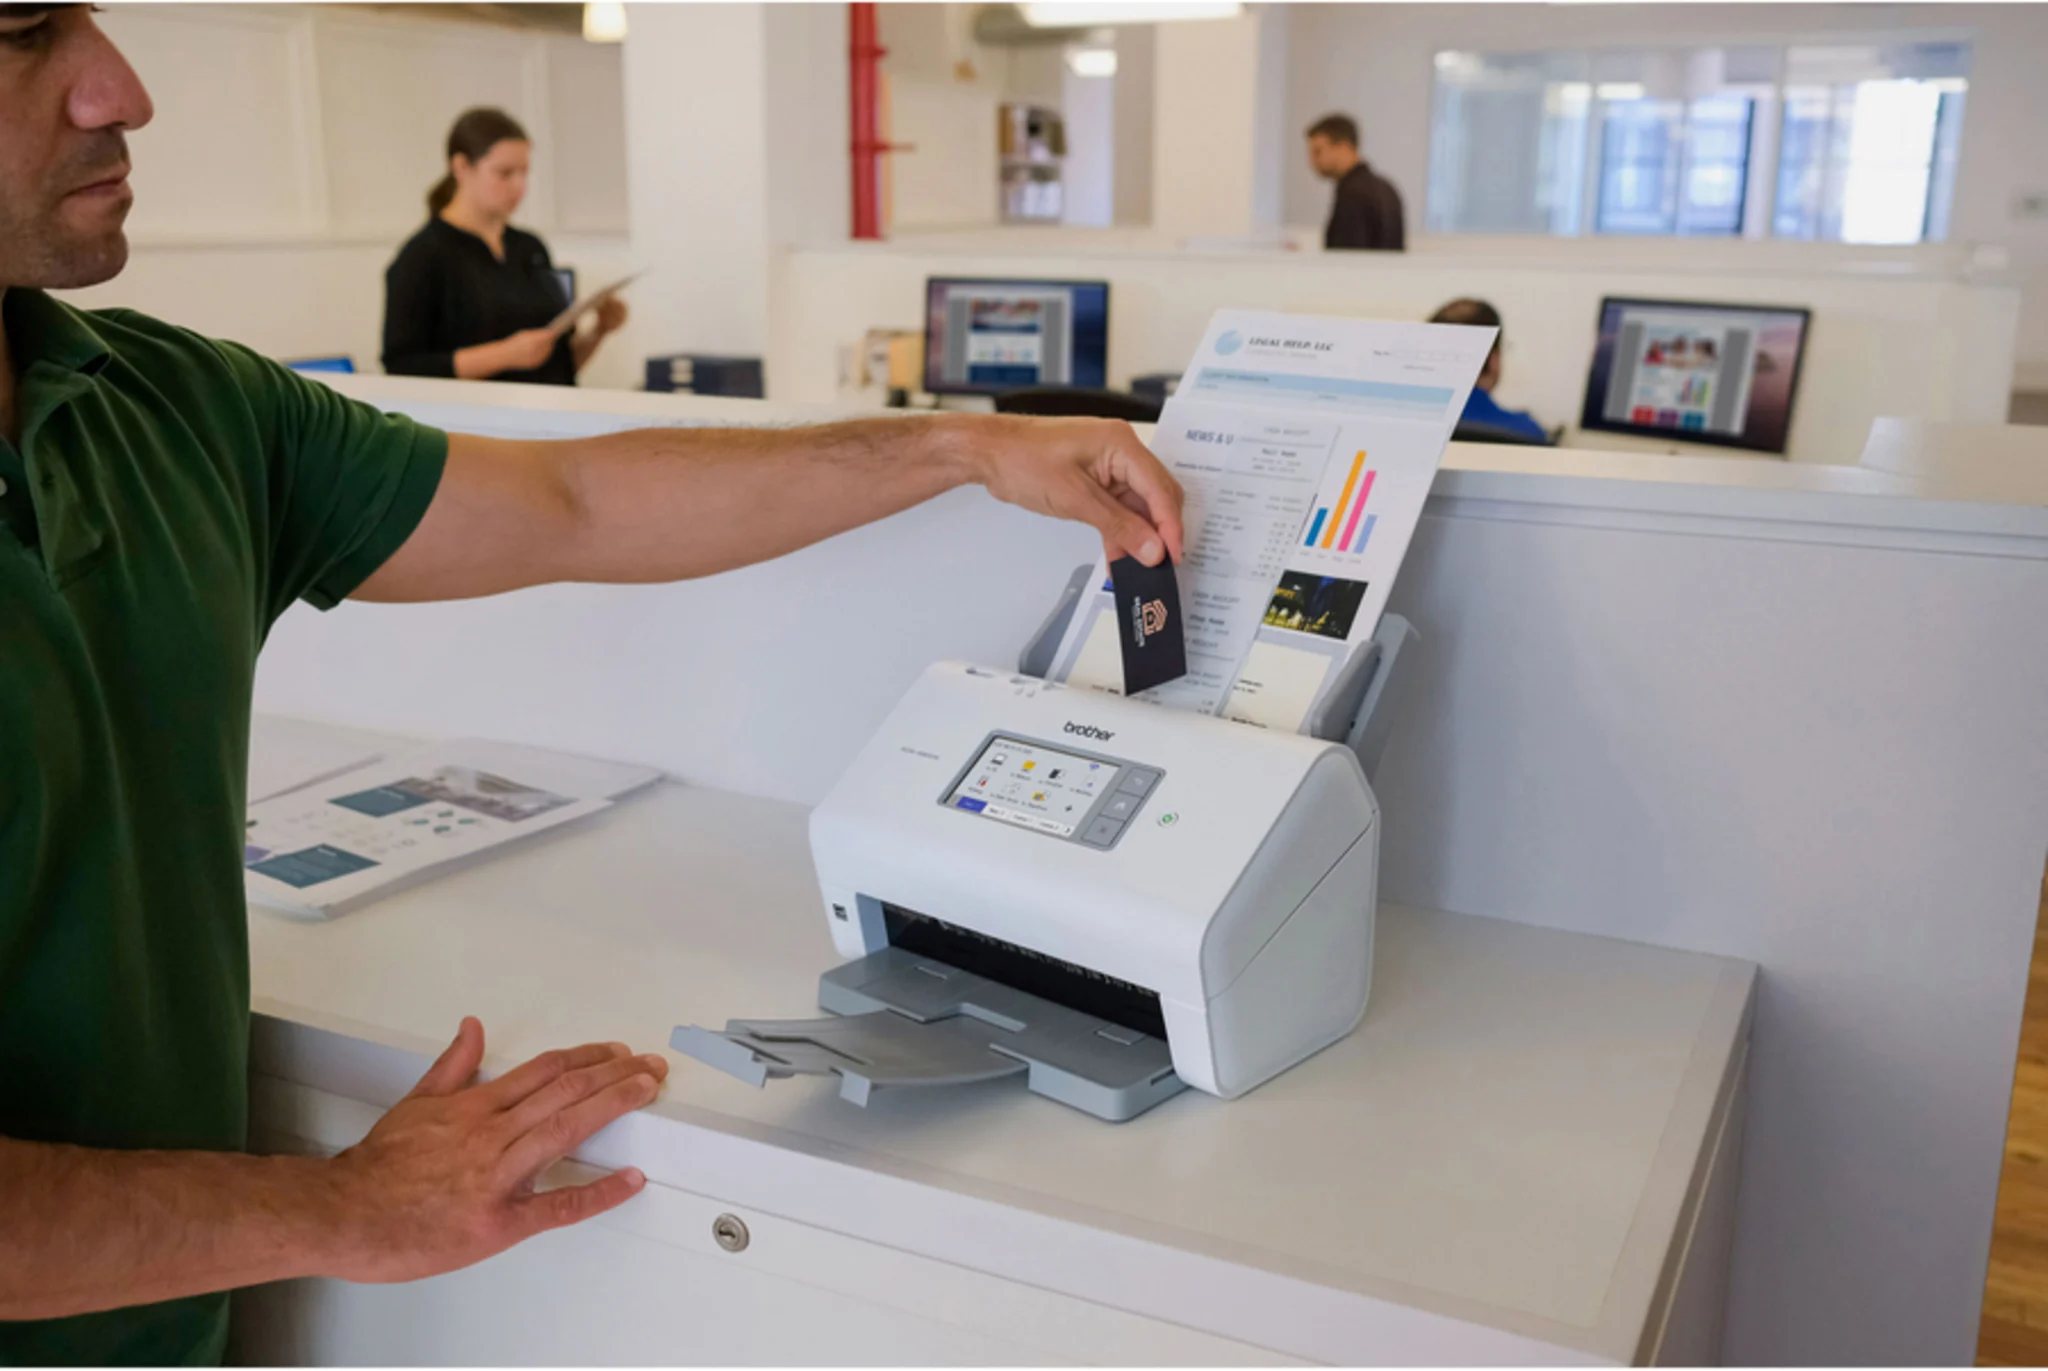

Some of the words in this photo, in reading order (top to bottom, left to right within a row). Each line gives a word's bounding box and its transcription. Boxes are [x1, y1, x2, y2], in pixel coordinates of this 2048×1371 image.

[1249, 336, 1281, 347] LEGAL
[1314, 342, 1334, 352] LLC
[1186, 429, 1214, 443] NEWS
[1215, 433, 1223, 444] &
[1063, 720, 1116, 741] brother
